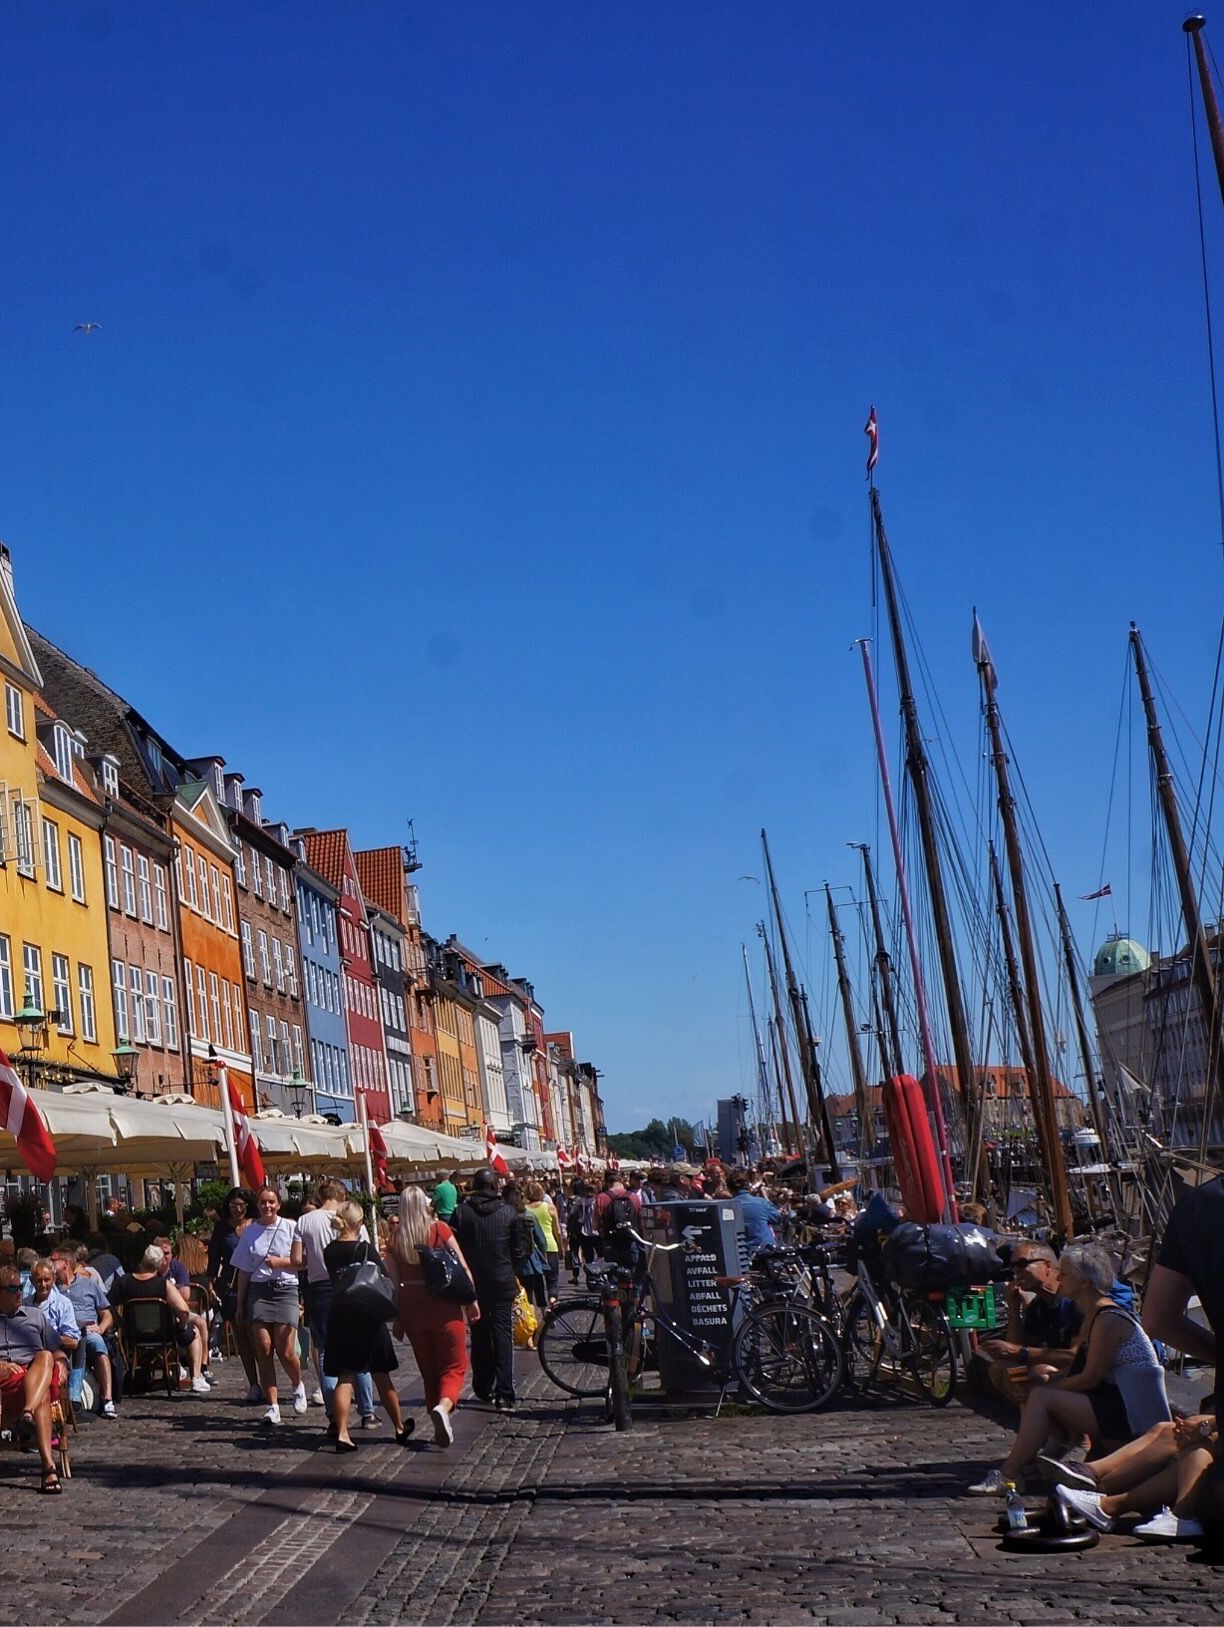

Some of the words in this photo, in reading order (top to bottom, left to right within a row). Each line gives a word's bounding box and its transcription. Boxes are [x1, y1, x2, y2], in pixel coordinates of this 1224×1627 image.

[686, 1266, 718, 1275] AVFALL
[687, 1279, 718, 1288] LITTER
[689, 1291, 722, 1301] ABFALL
[691, 1303, 728, 1313] DÉCHETS
[692, 1317, 728, 1326] BASURA
